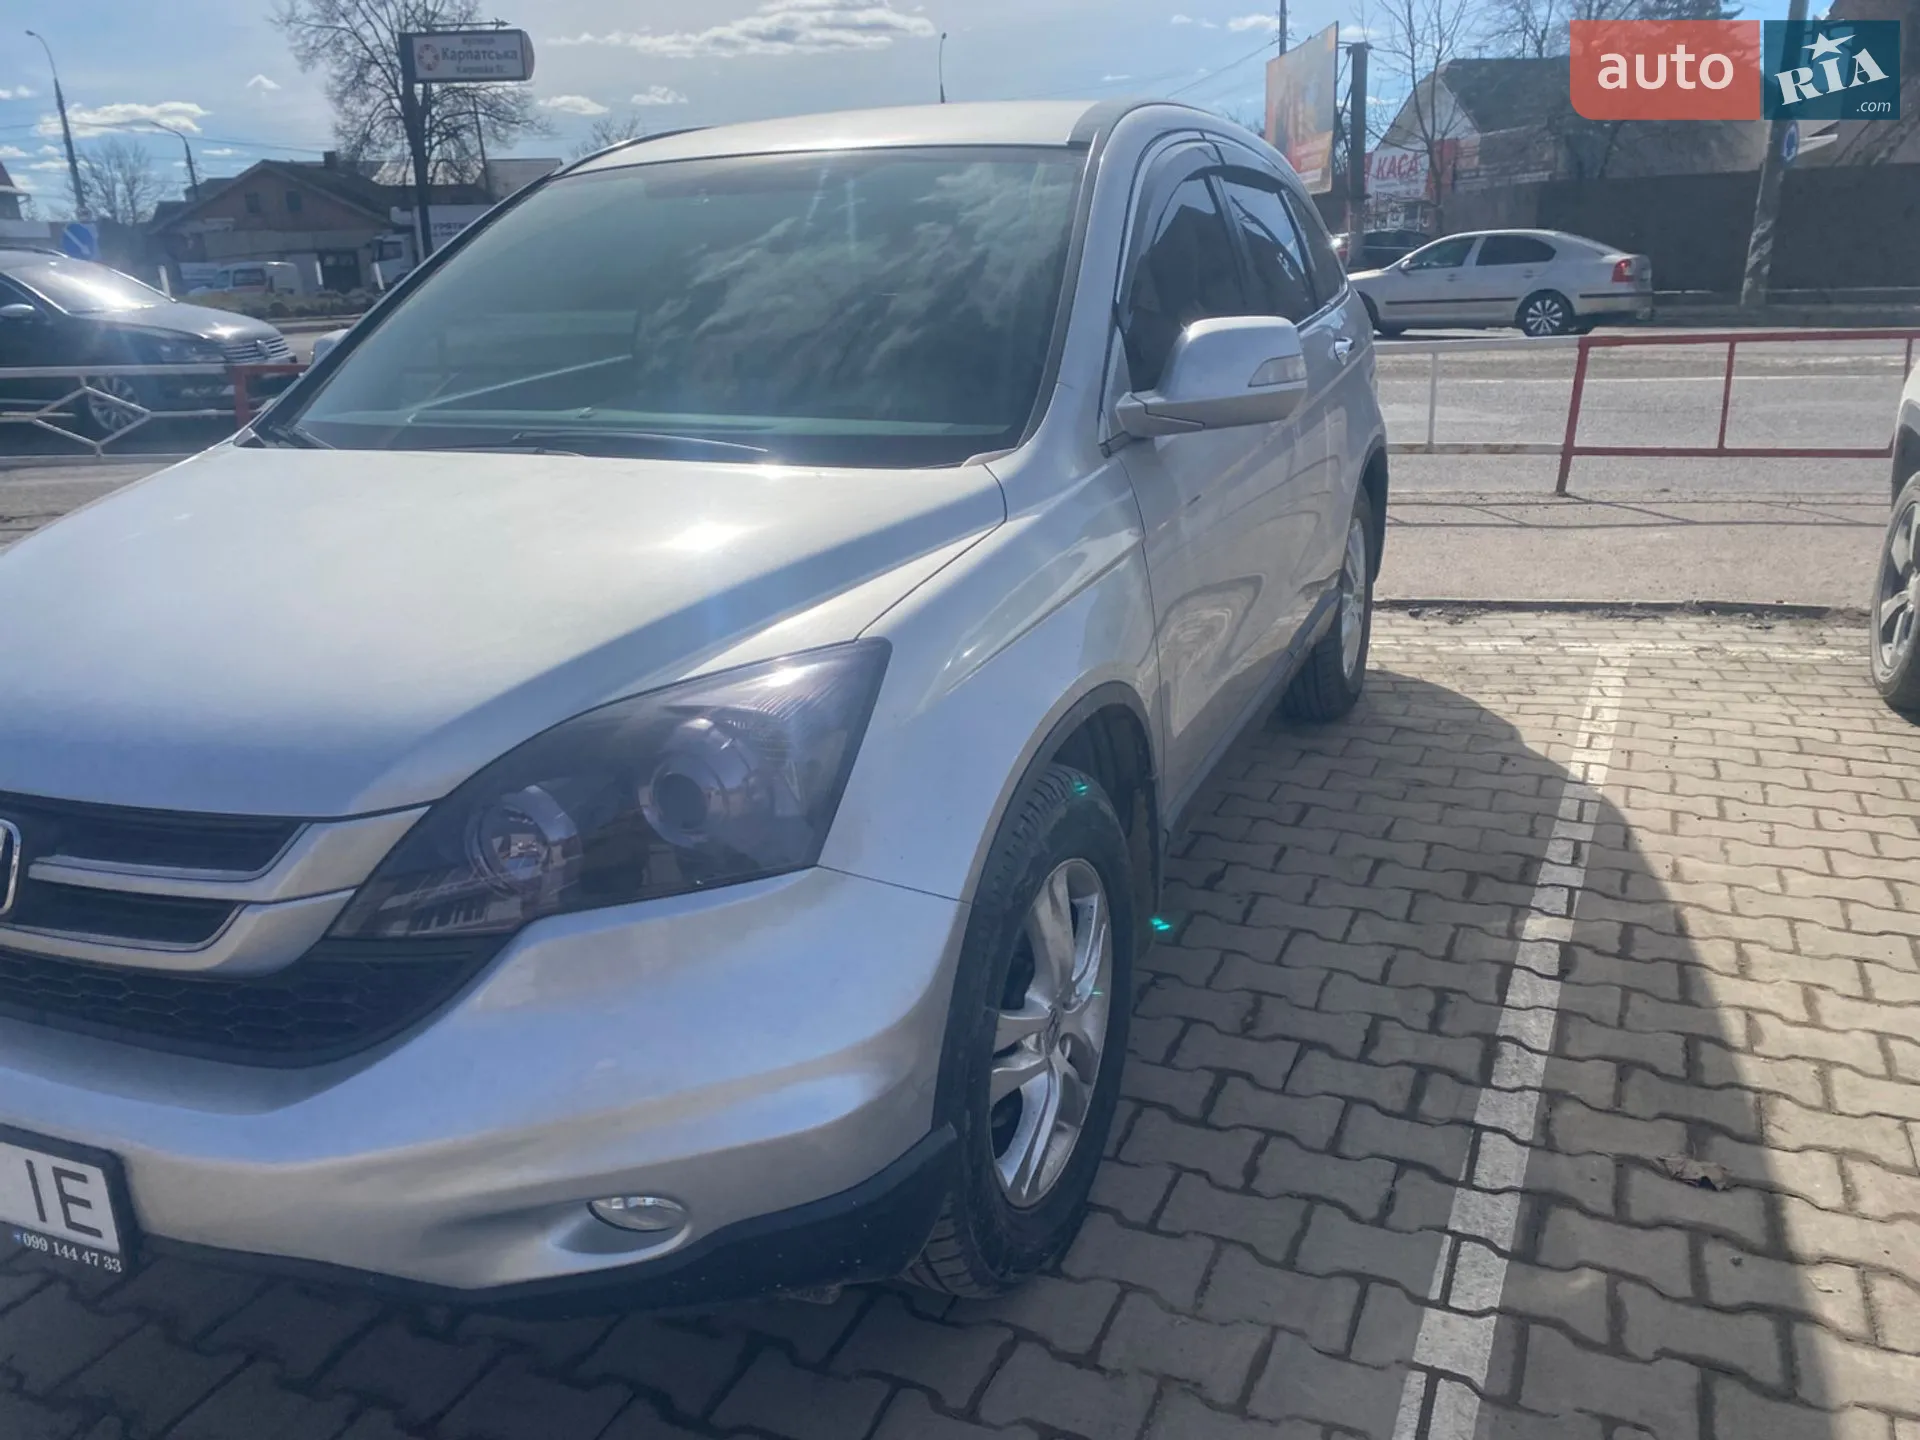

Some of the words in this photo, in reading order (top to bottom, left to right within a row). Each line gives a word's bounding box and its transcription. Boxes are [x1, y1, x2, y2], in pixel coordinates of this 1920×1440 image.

[441, 48, 518, 63] Карпатська
[1376, 152, 1419, 178] КАСА
[25, 1159, 102, 1238] IE
[22, 1233, 48, 1252] 099
[54, 1242, 78, 1261] 144
[82, 1251, 99, 1267] 47
[103, 1255, 122, 1273] 33
